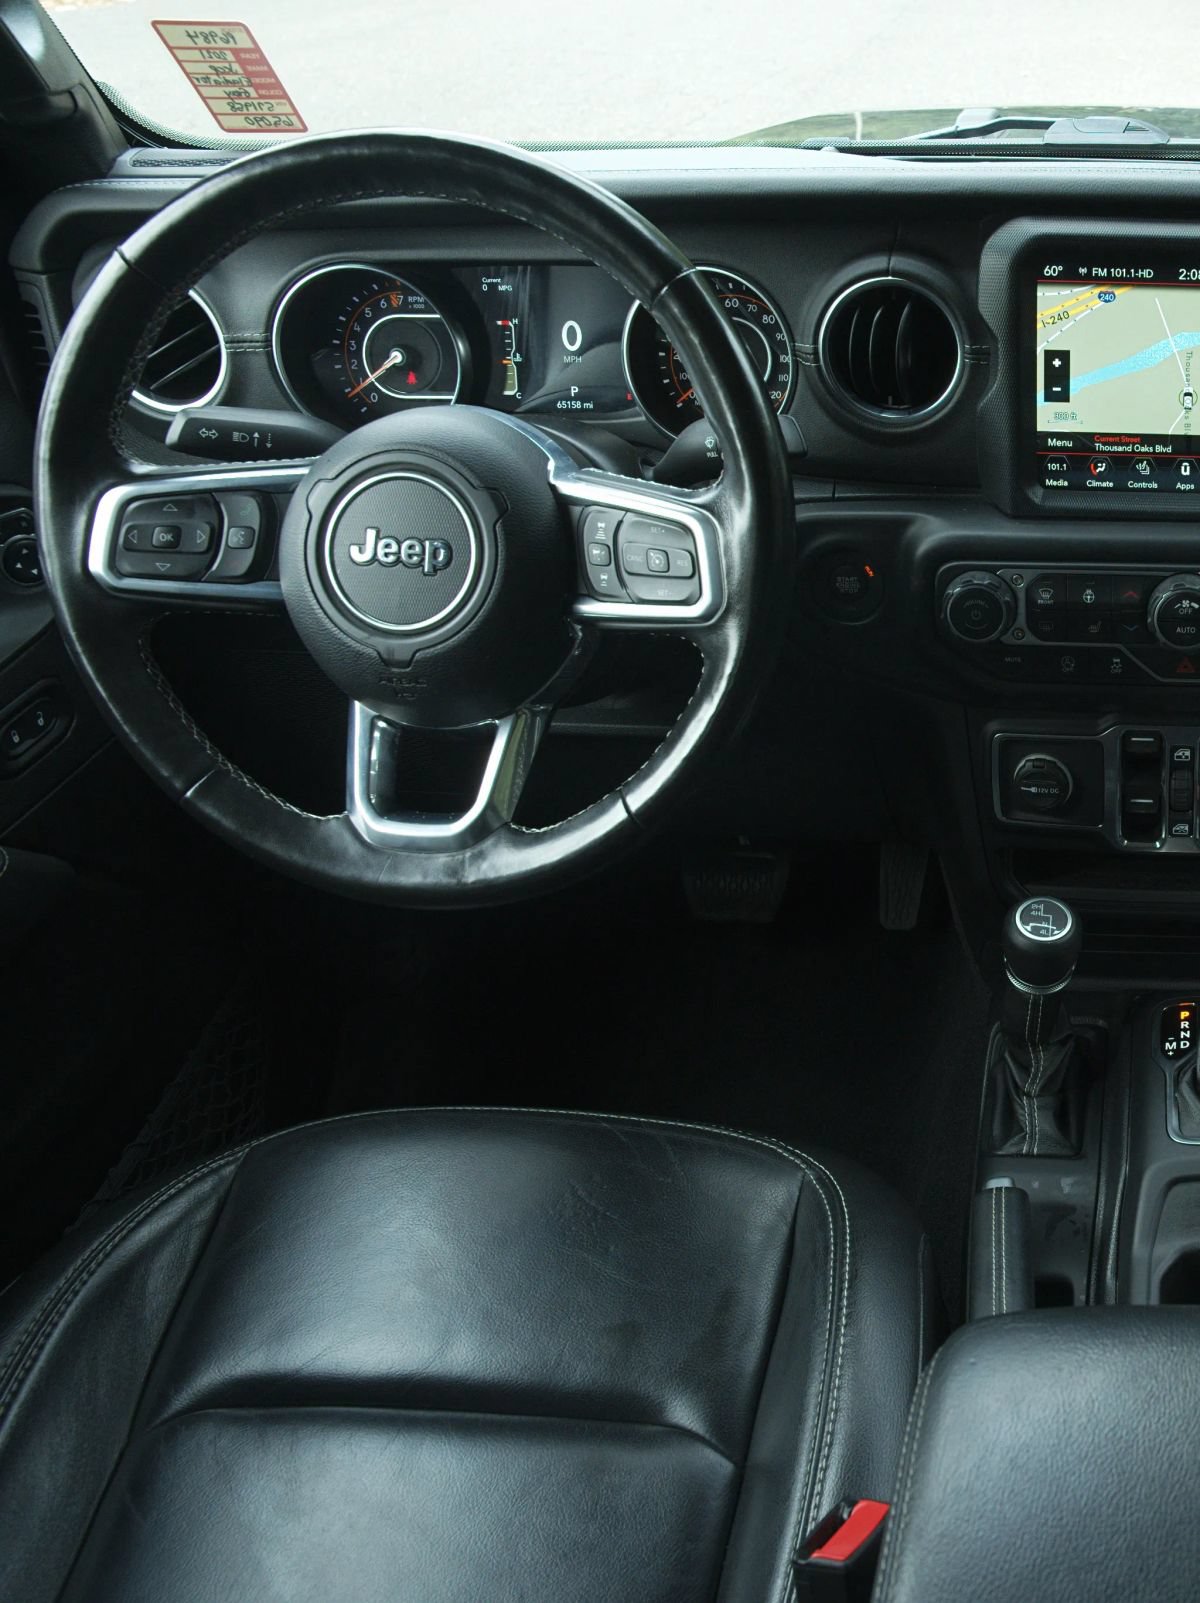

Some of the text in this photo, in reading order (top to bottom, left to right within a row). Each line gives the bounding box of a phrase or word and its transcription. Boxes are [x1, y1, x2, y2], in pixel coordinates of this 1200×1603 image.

[1044, 266, 1063, 276] 60°
[1092, 268, 1154, 278] FM 101.1-HD
[380, 298, 387, 308] 6
[397, 296, 404, 305] 7
[725, 299, 739, 308] 60
[365, 308, 372, 317] 5
[747, 304, 757, 312] 70
[762, 315, 775, 324] 80
[354, 323, 360, 332] 4
[562, 320, 582, 352] 0
[776, 333, 786, 341] 90
[350, 341, 356, 350] 3
[351, 360, 358, 369] 2
[571, 386, 578, 396] P
[370, 393, 378, 402] 0
[557, 401, 593, 409] 65158 mi
[1048, 438, 1072, 447] Menu
[1095, 443, 1172, 453] Thousand Oaks Blvd
[1128, 481, 1158, 489] Controls
[1176, 482, 1194, 491] Apps
[159, 533, 173, 542] OK
[350, 527, 452, 576] Jeep
[1180, 1011, 1190, 1019] P
[1180, 1030, 1190, 1038] N
[1165, 1040, 1190, 1050] M D
